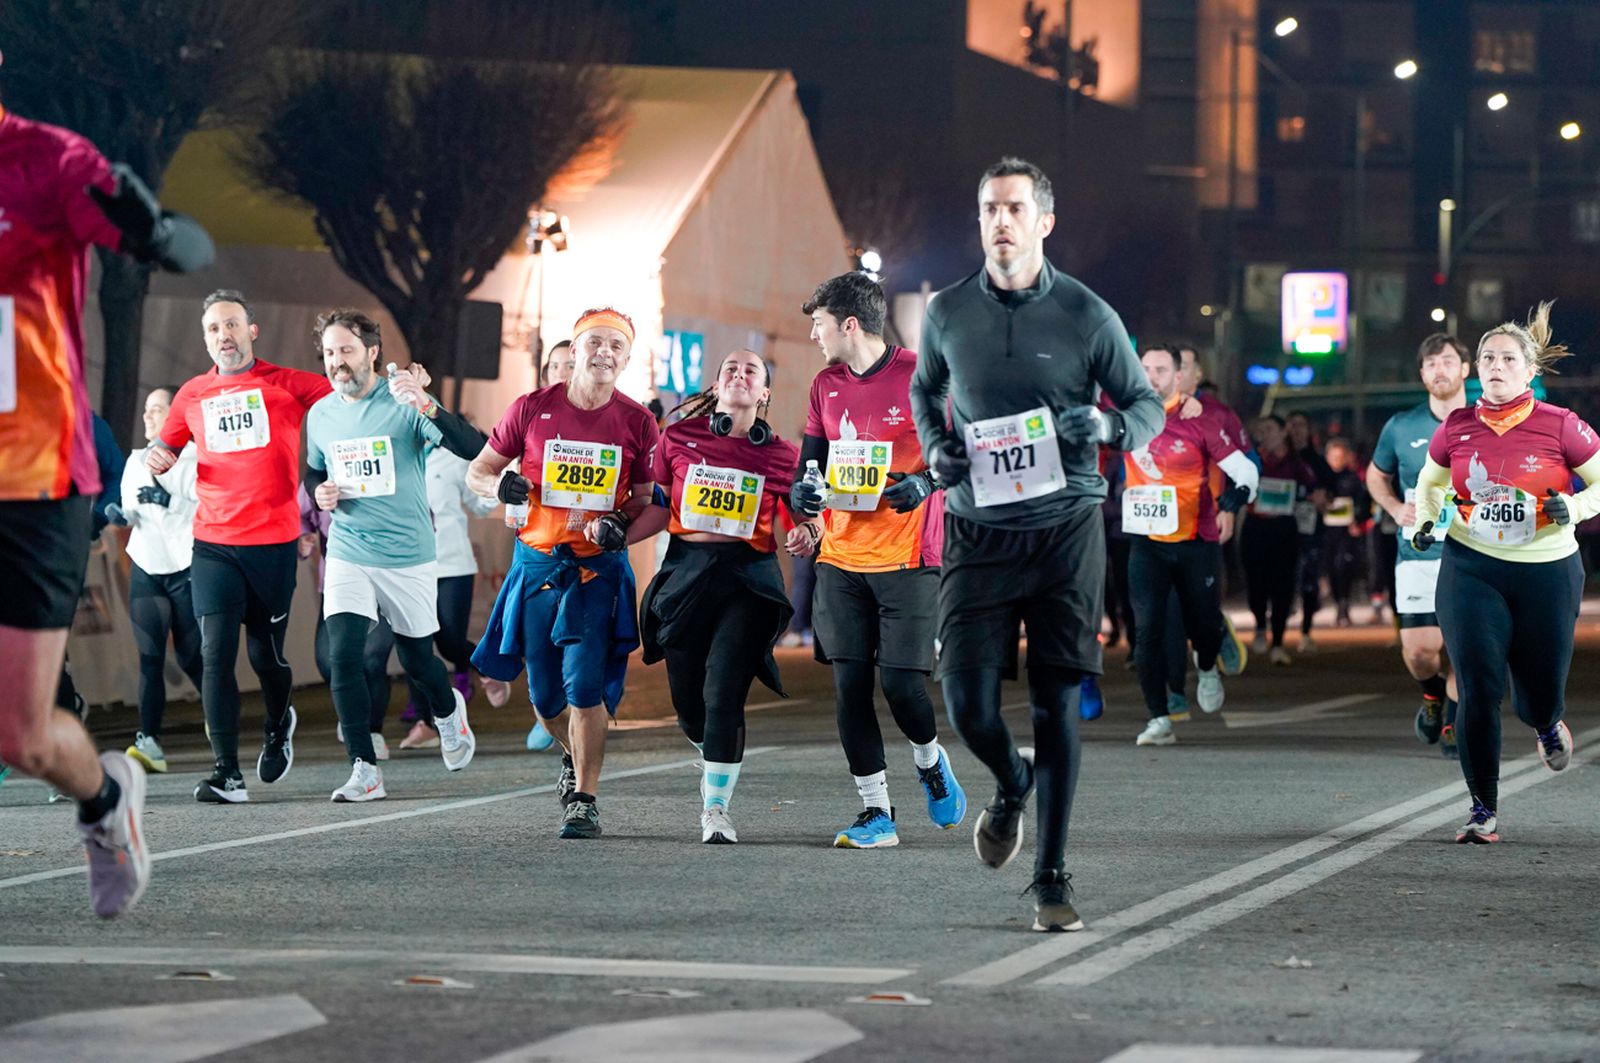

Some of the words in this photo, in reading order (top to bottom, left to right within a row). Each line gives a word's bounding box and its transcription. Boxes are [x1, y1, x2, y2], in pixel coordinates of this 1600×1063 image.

[218, 412, 253, 432] 4179
[552, 454, 568, 462] SAN
[562, 447, 584, 456] NOCHE
[989, 444, 1036, 475] 7127
[344, 458, 381, 478] 5091
[556, 463, 607, 487] 2892
[703, 472, 726, 481] NOCHE
[839, 466, 879, 487] 2890
[694, 478, 709, 486] SAN
[697, 487, 746, 513] 2891
[1134, 503, 1168, 518] 5528
[1480, 502, 1525, 523] 5966
